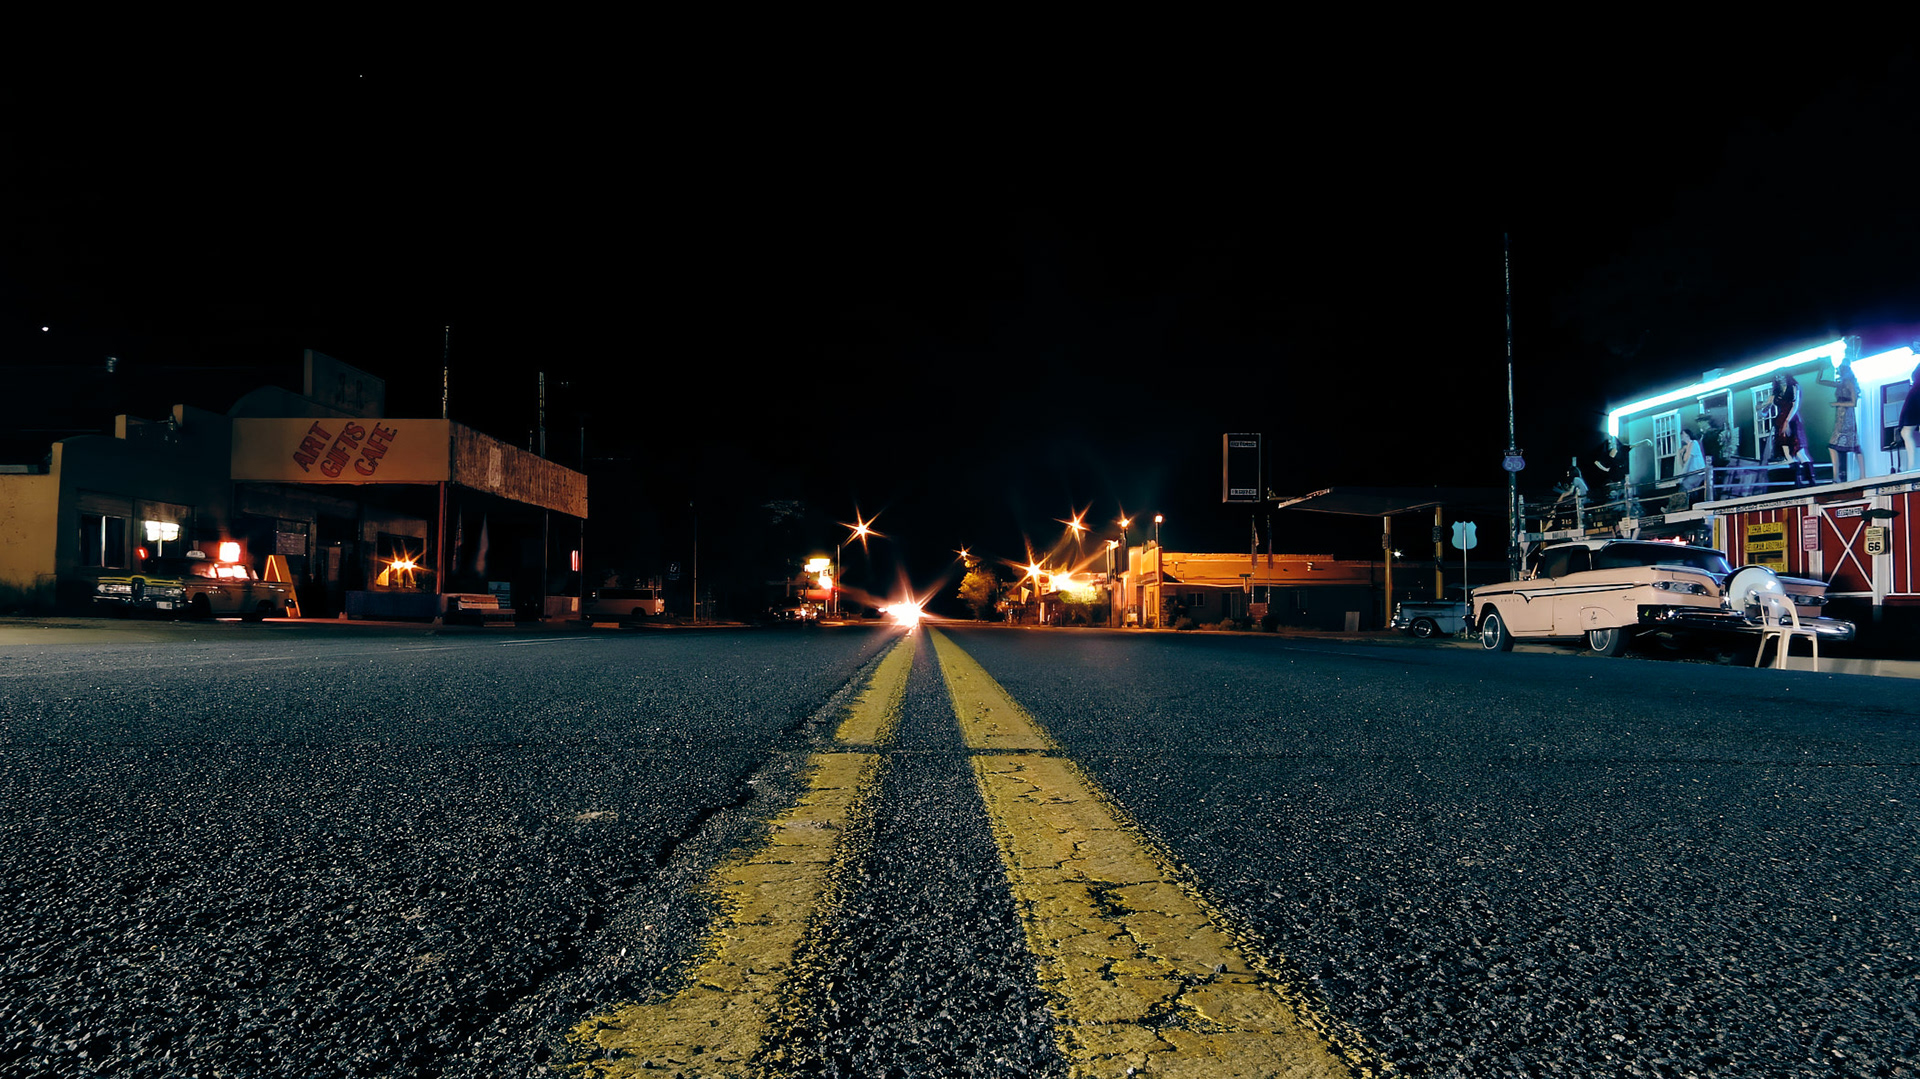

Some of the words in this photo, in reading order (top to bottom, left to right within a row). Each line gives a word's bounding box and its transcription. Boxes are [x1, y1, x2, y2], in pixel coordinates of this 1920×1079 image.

[293, 420, 332, 473] ART
[320, 421, 366, 478] GIFTS
[354, 422, 398, 476] CAFE
[1868, 541, 1881, 552] 66
